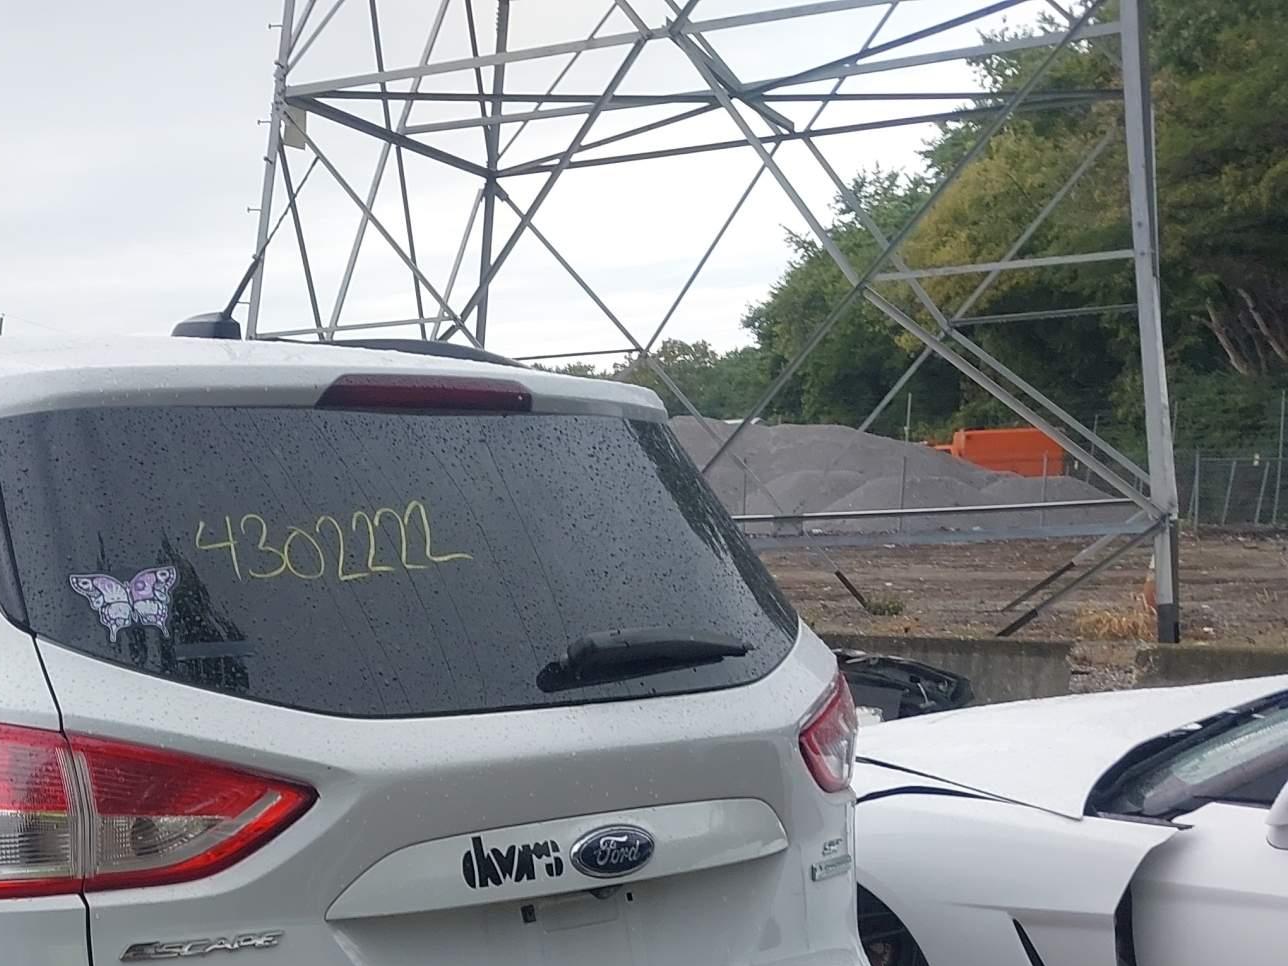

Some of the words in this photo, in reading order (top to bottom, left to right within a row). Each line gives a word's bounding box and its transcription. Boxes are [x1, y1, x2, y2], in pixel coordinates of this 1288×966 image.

[194, 500, 474, 582] 4302222
[593, 835, 641, 866] Ford
[119, 929, 285, 962] ESCAPE
